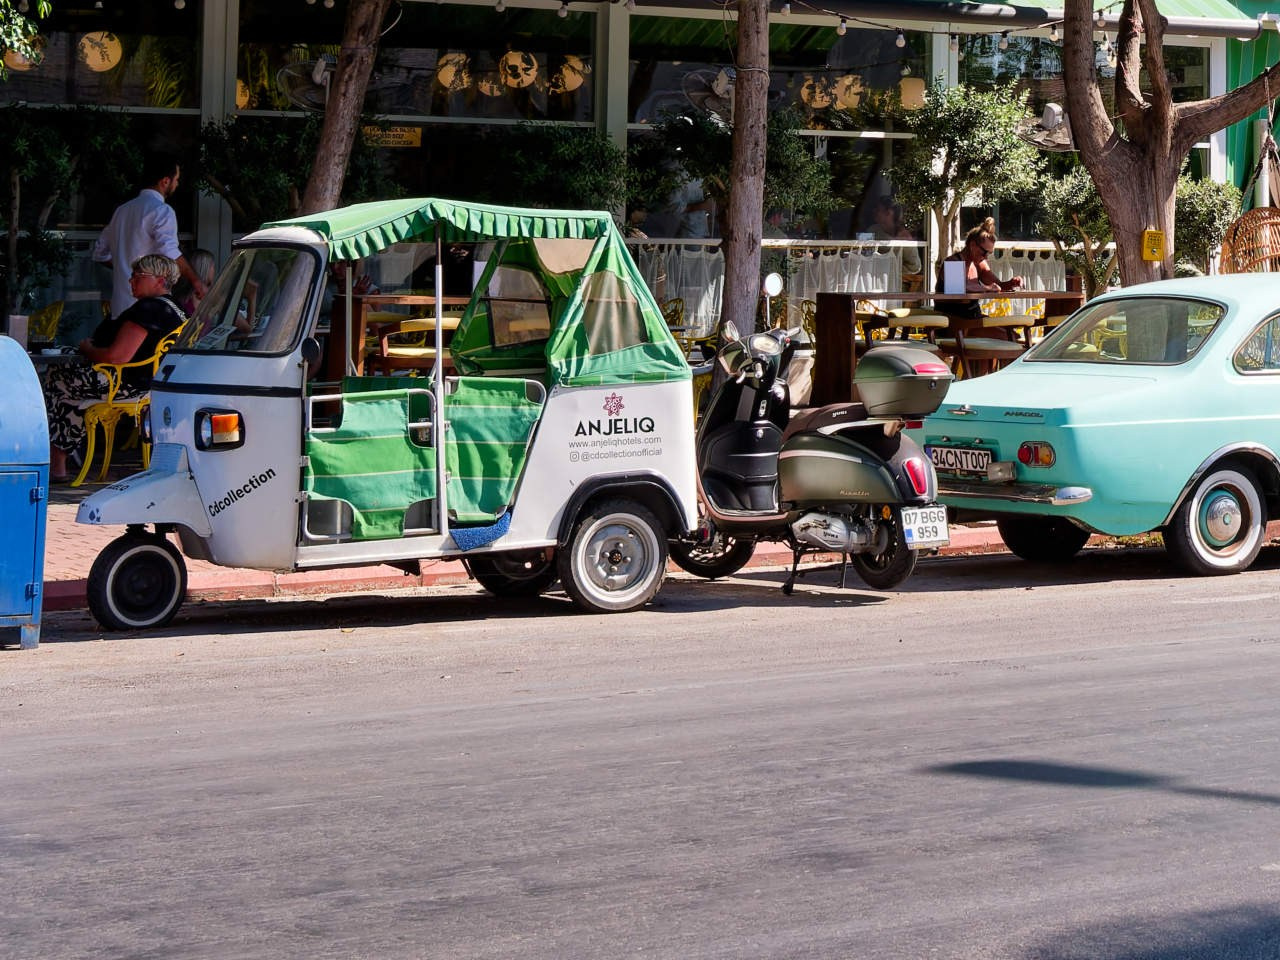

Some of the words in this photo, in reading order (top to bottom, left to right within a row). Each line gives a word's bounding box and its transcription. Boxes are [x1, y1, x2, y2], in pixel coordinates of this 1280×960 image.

[574, 416, 655, 437] ANJELIQ
[568, 436, 662, 449] www.anjeliqhotels.com
[580, 448, 663, 461] @cdcollectionofficial
[904, 513, 918, 525] 07
[920, 505, 946, 523] BGG
[917, 525, 939, 539] 959
